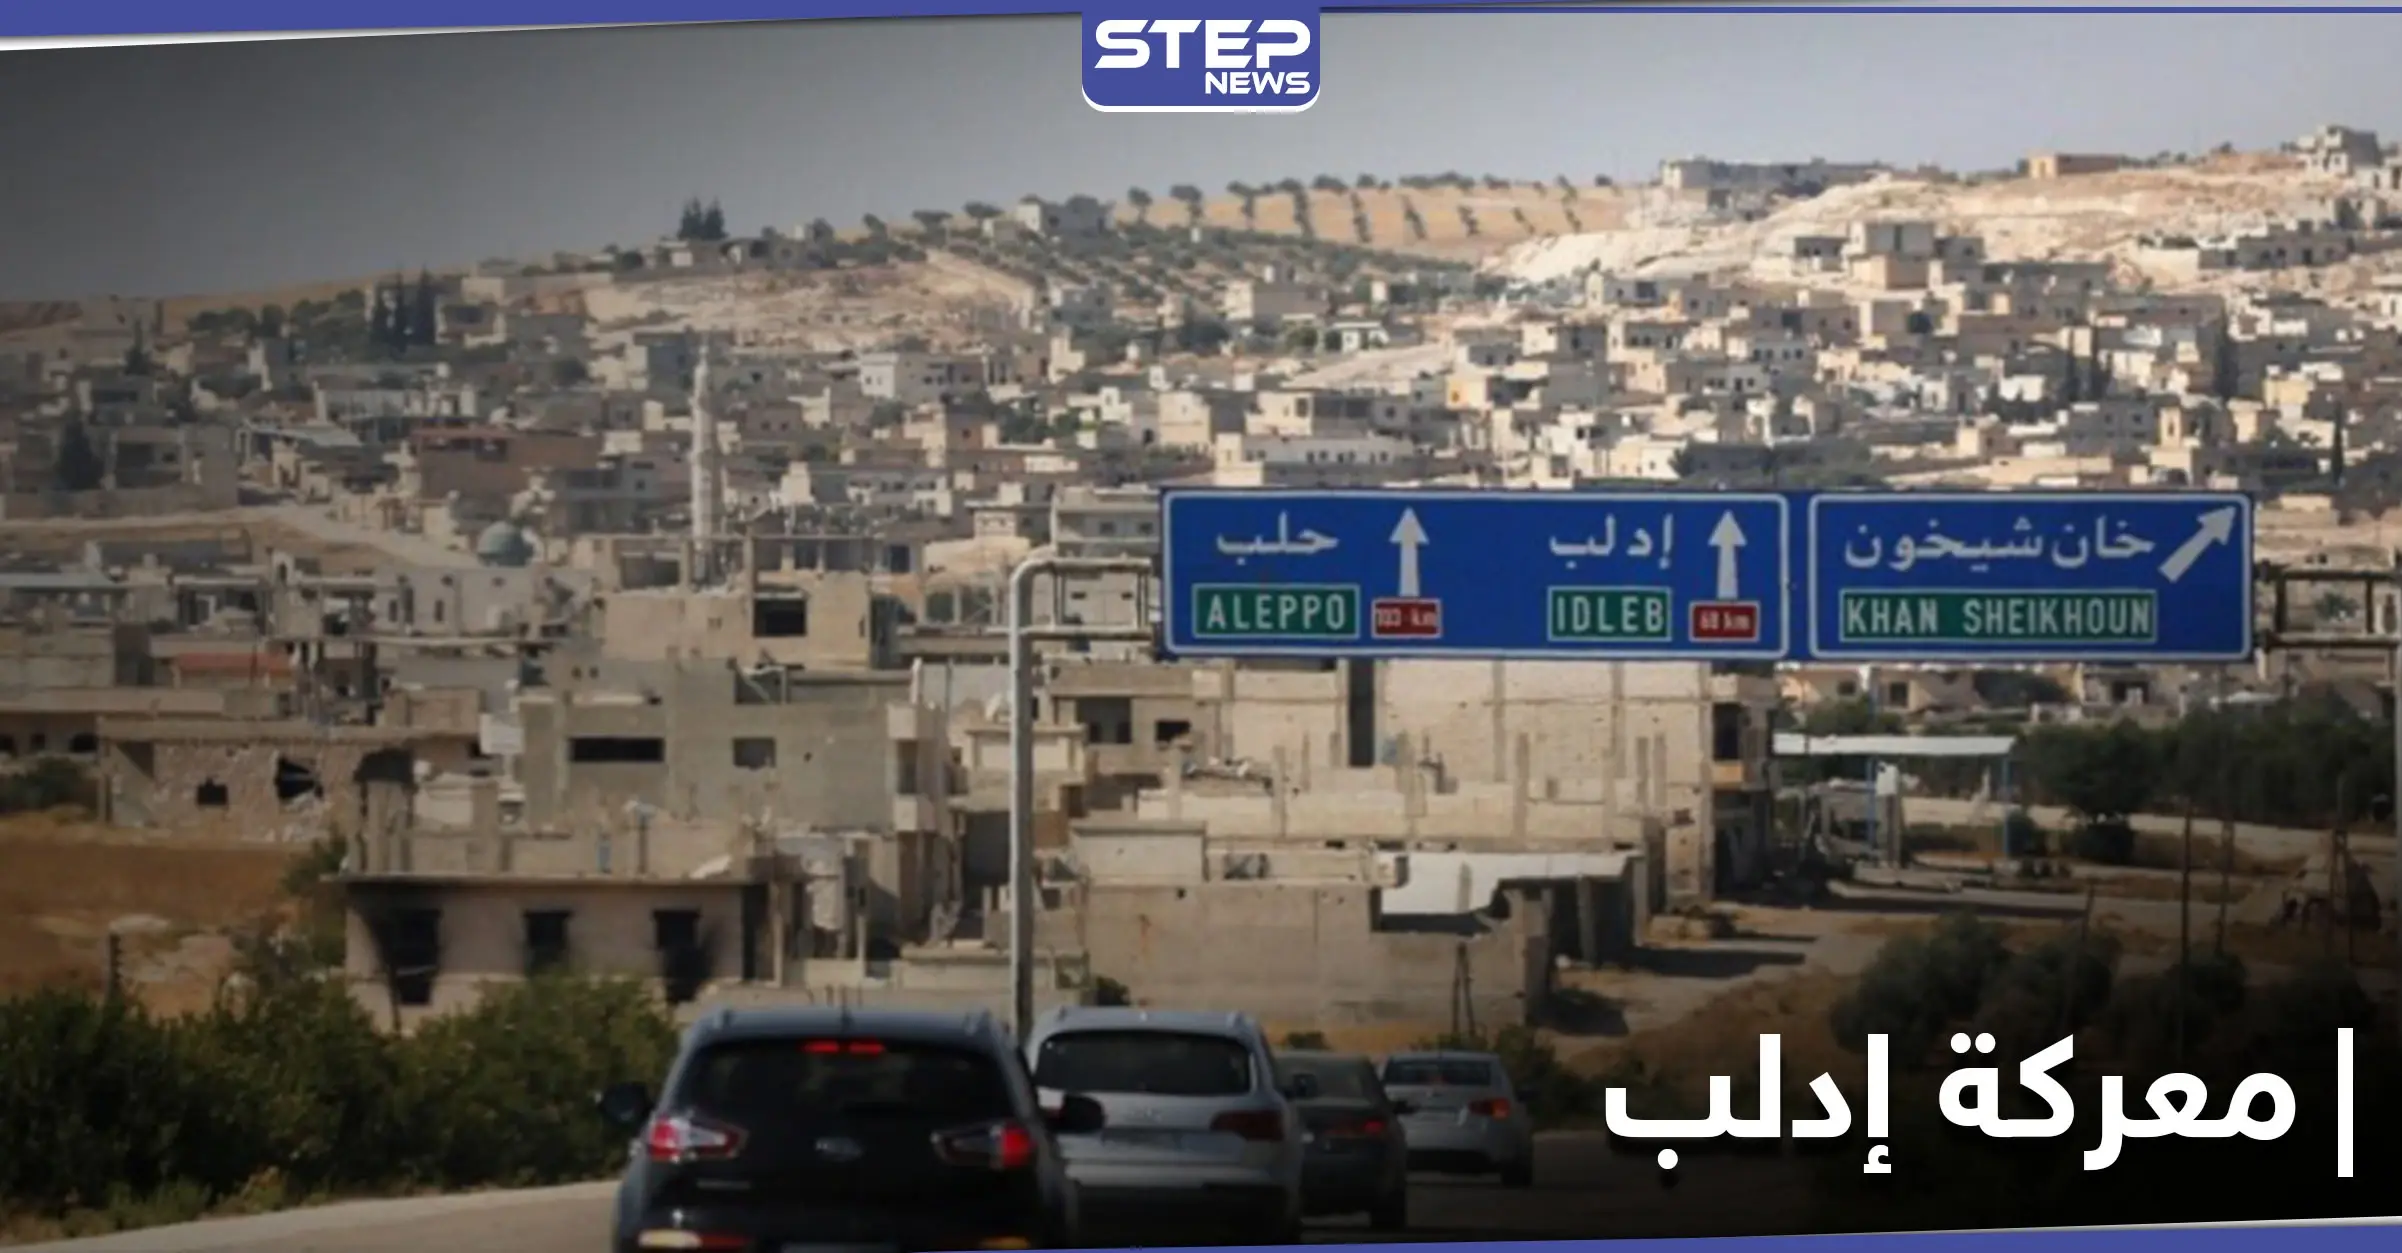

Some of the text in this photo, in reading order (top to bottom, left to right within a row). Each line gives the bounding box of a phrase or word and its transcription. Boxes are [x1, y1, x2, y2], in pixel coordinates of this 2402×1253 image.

[1216, 510, 1340, 566] حلب
[1549, 512, 1674, 570] إدلب
[1844, 514, 2156, 573] خان شيخون
[1205, 593, 1347, 631] ALEPPO
[1555, 595, 1666, 634] IDLEB
[1845, 597, 2152, 635] KHAN SHEIKHOUN
